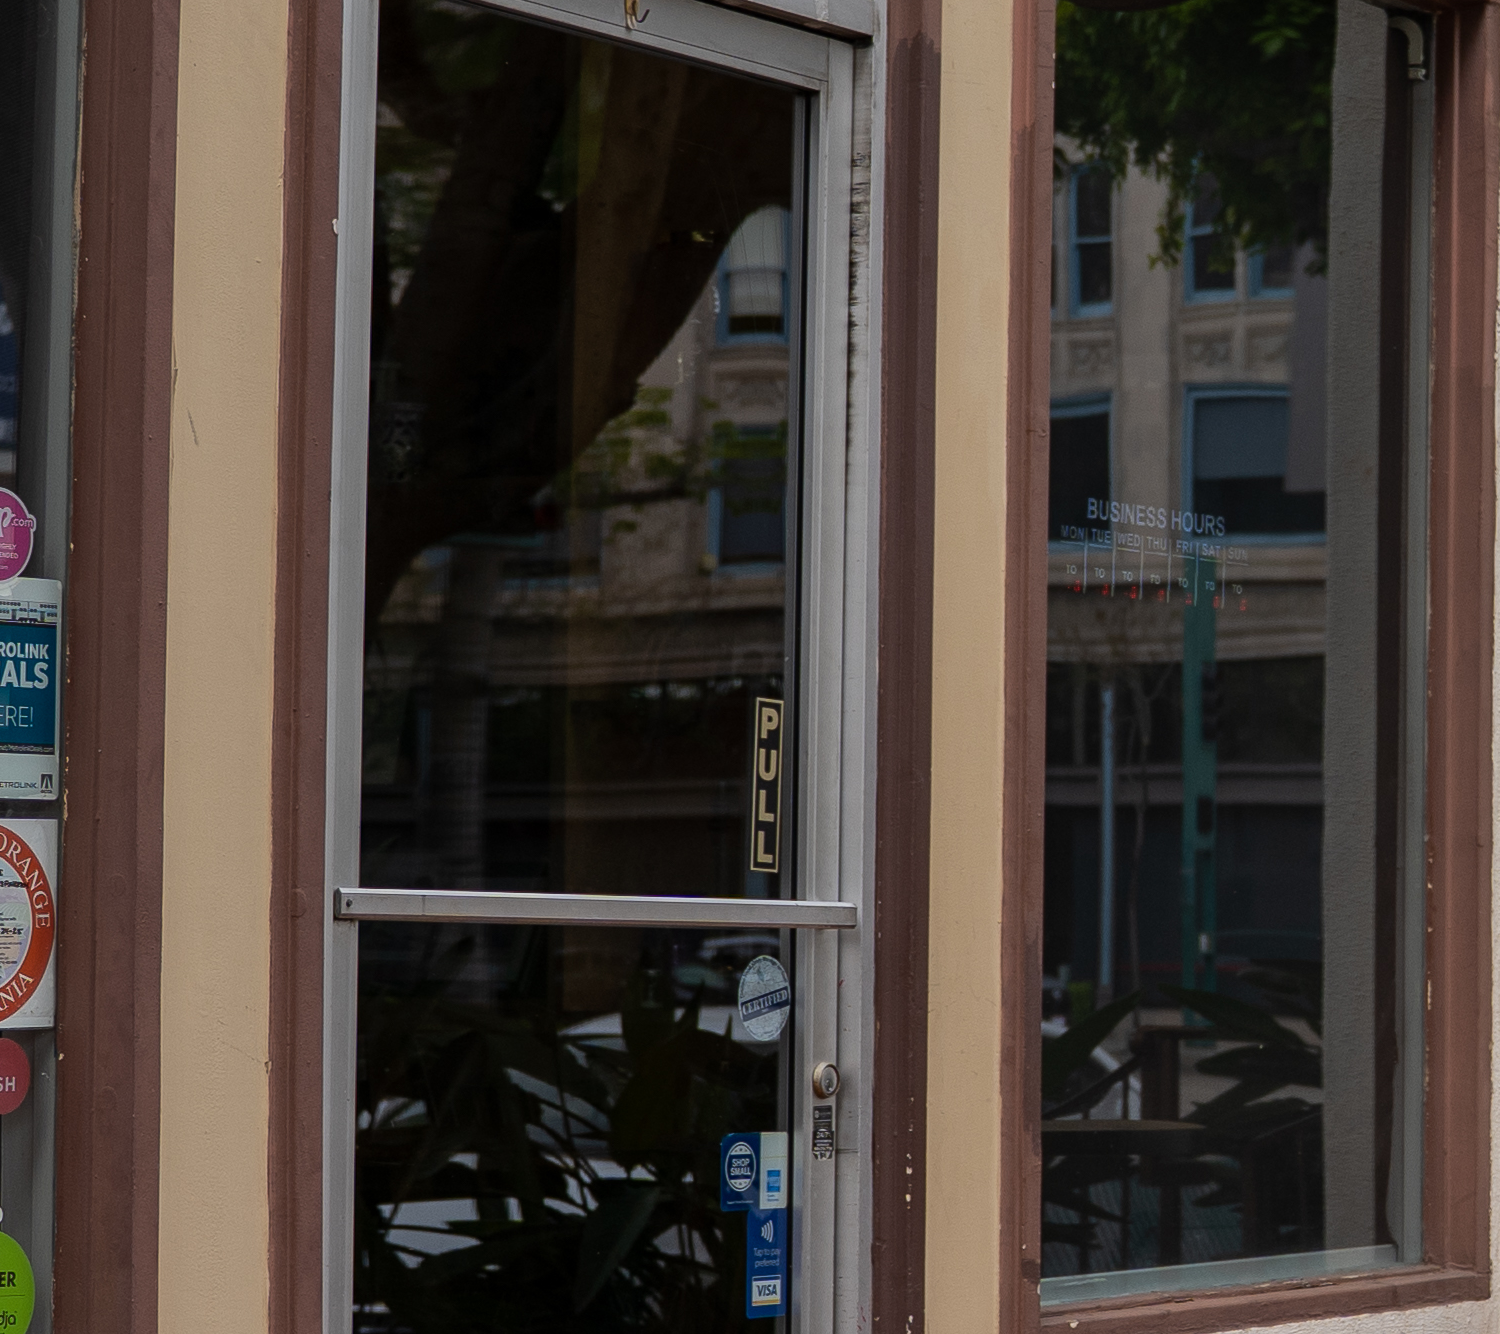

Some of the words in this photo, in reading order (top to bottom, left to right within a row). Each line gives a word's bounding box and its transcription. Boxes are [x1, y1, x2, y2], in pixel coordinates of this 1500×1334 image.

[1087, 497, 1167, 529] BUSINESS
[1171, 509, 1226, 537] HOURS
[1060, 524, 1085, 540] MON
[1091, 528, 1111, 544] TUE
[1117, 532, 1141, 547] WED
[1146, 536, 1167, 551] THU
[1176, 539, 1193, 554] FRI
[1202, 543, 1221, 557] SAT
[1228, 546, 1248, 561] SUN
[756, 707, 779, 864] PULL
[742, 989, 788, 1015] CERTIFIED
[730, 1167, 751, 1175] SMALL
[732, 1158, 750, 1167] SHOP
[756, 1284, 777, 1297] VISA
